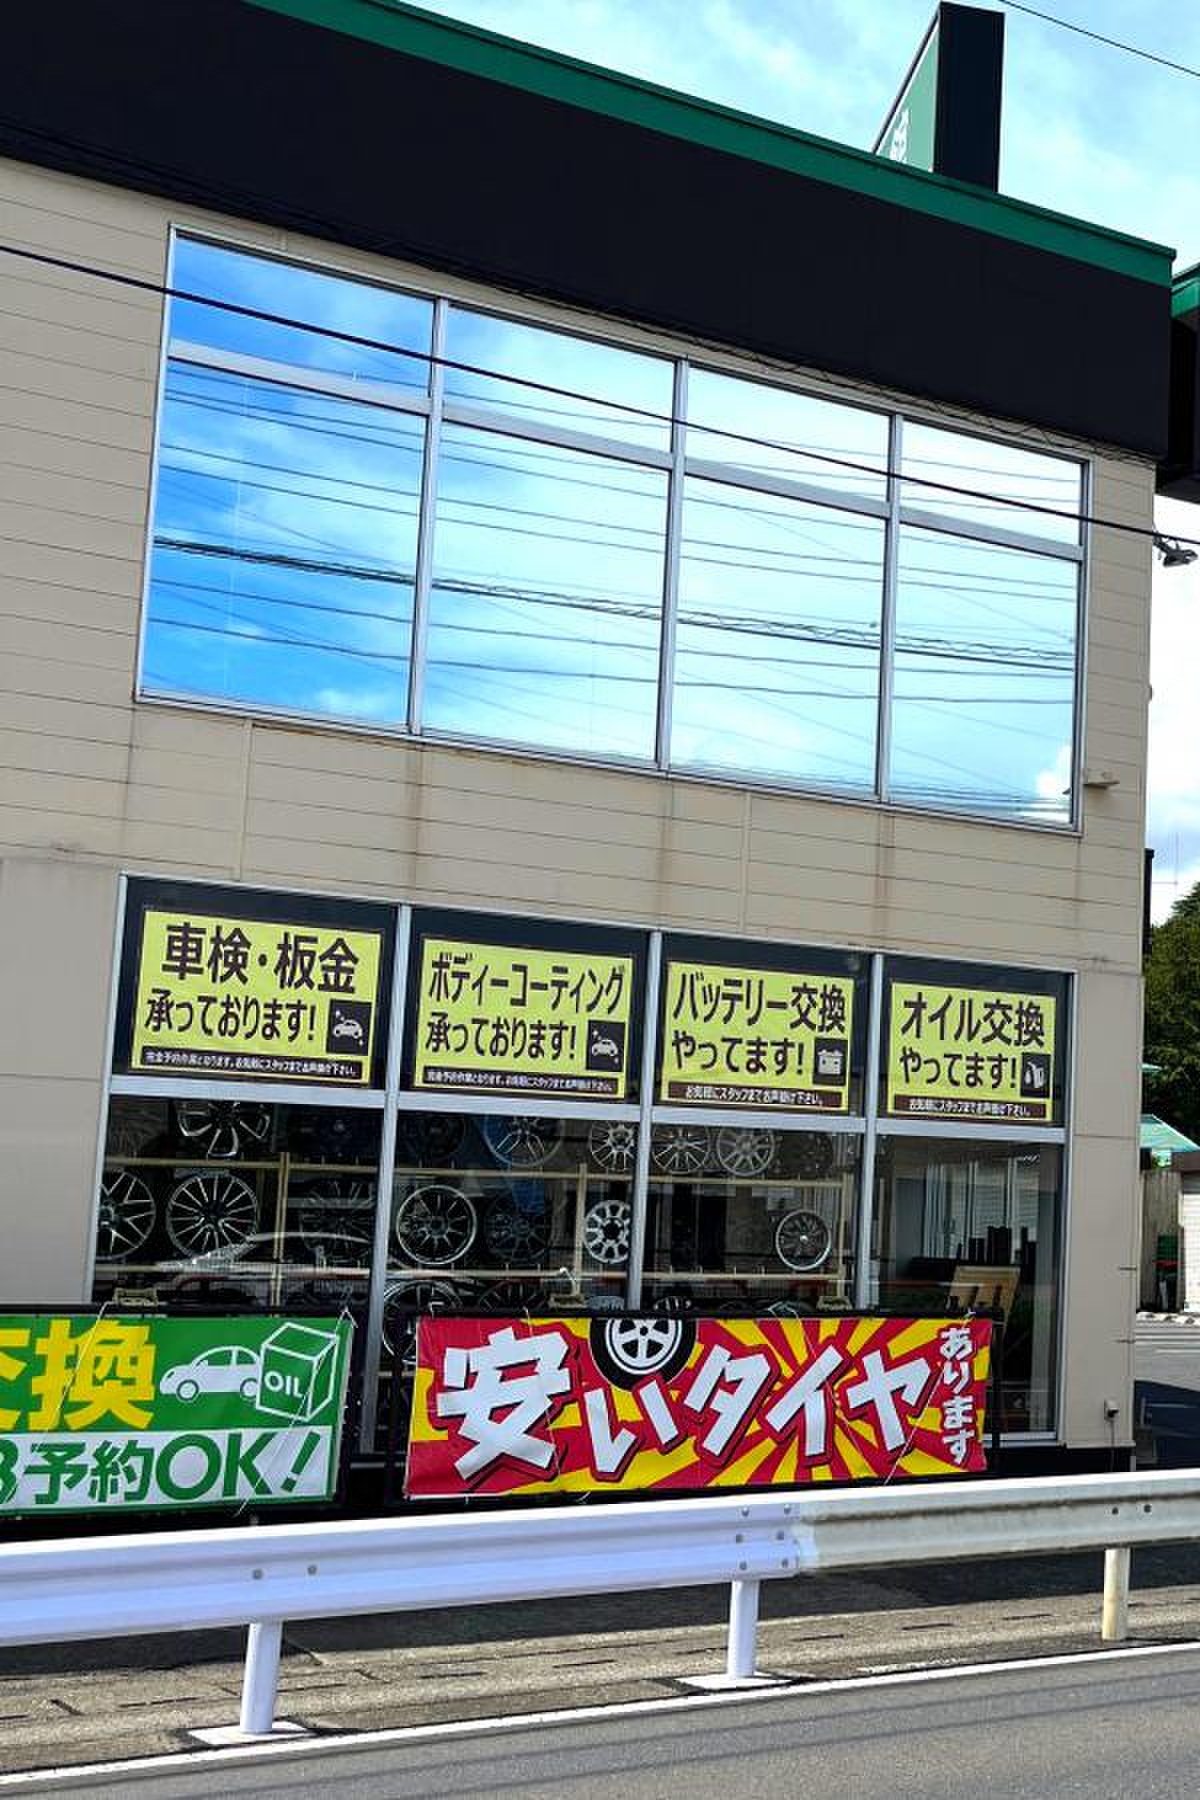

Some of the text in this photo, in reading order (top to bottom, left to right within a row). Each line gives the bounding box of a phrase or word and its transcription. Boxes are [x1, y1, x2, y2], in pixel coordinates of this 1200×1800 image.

[161, 921, 360, 995] 車検・板金
[428, 951, 626, 1015] ボディーコーティング
[672, 971, 848, 1034] バッテリー交換
[899, 991, 1045, 1048] オイル交換
[0, 1319, 156, 1431] 換
[265, 1371, 305, 1399] OIL
[437, 1327, 930, 1480] 安いタイヤ
[938, 1326, 979, 1466] あります
